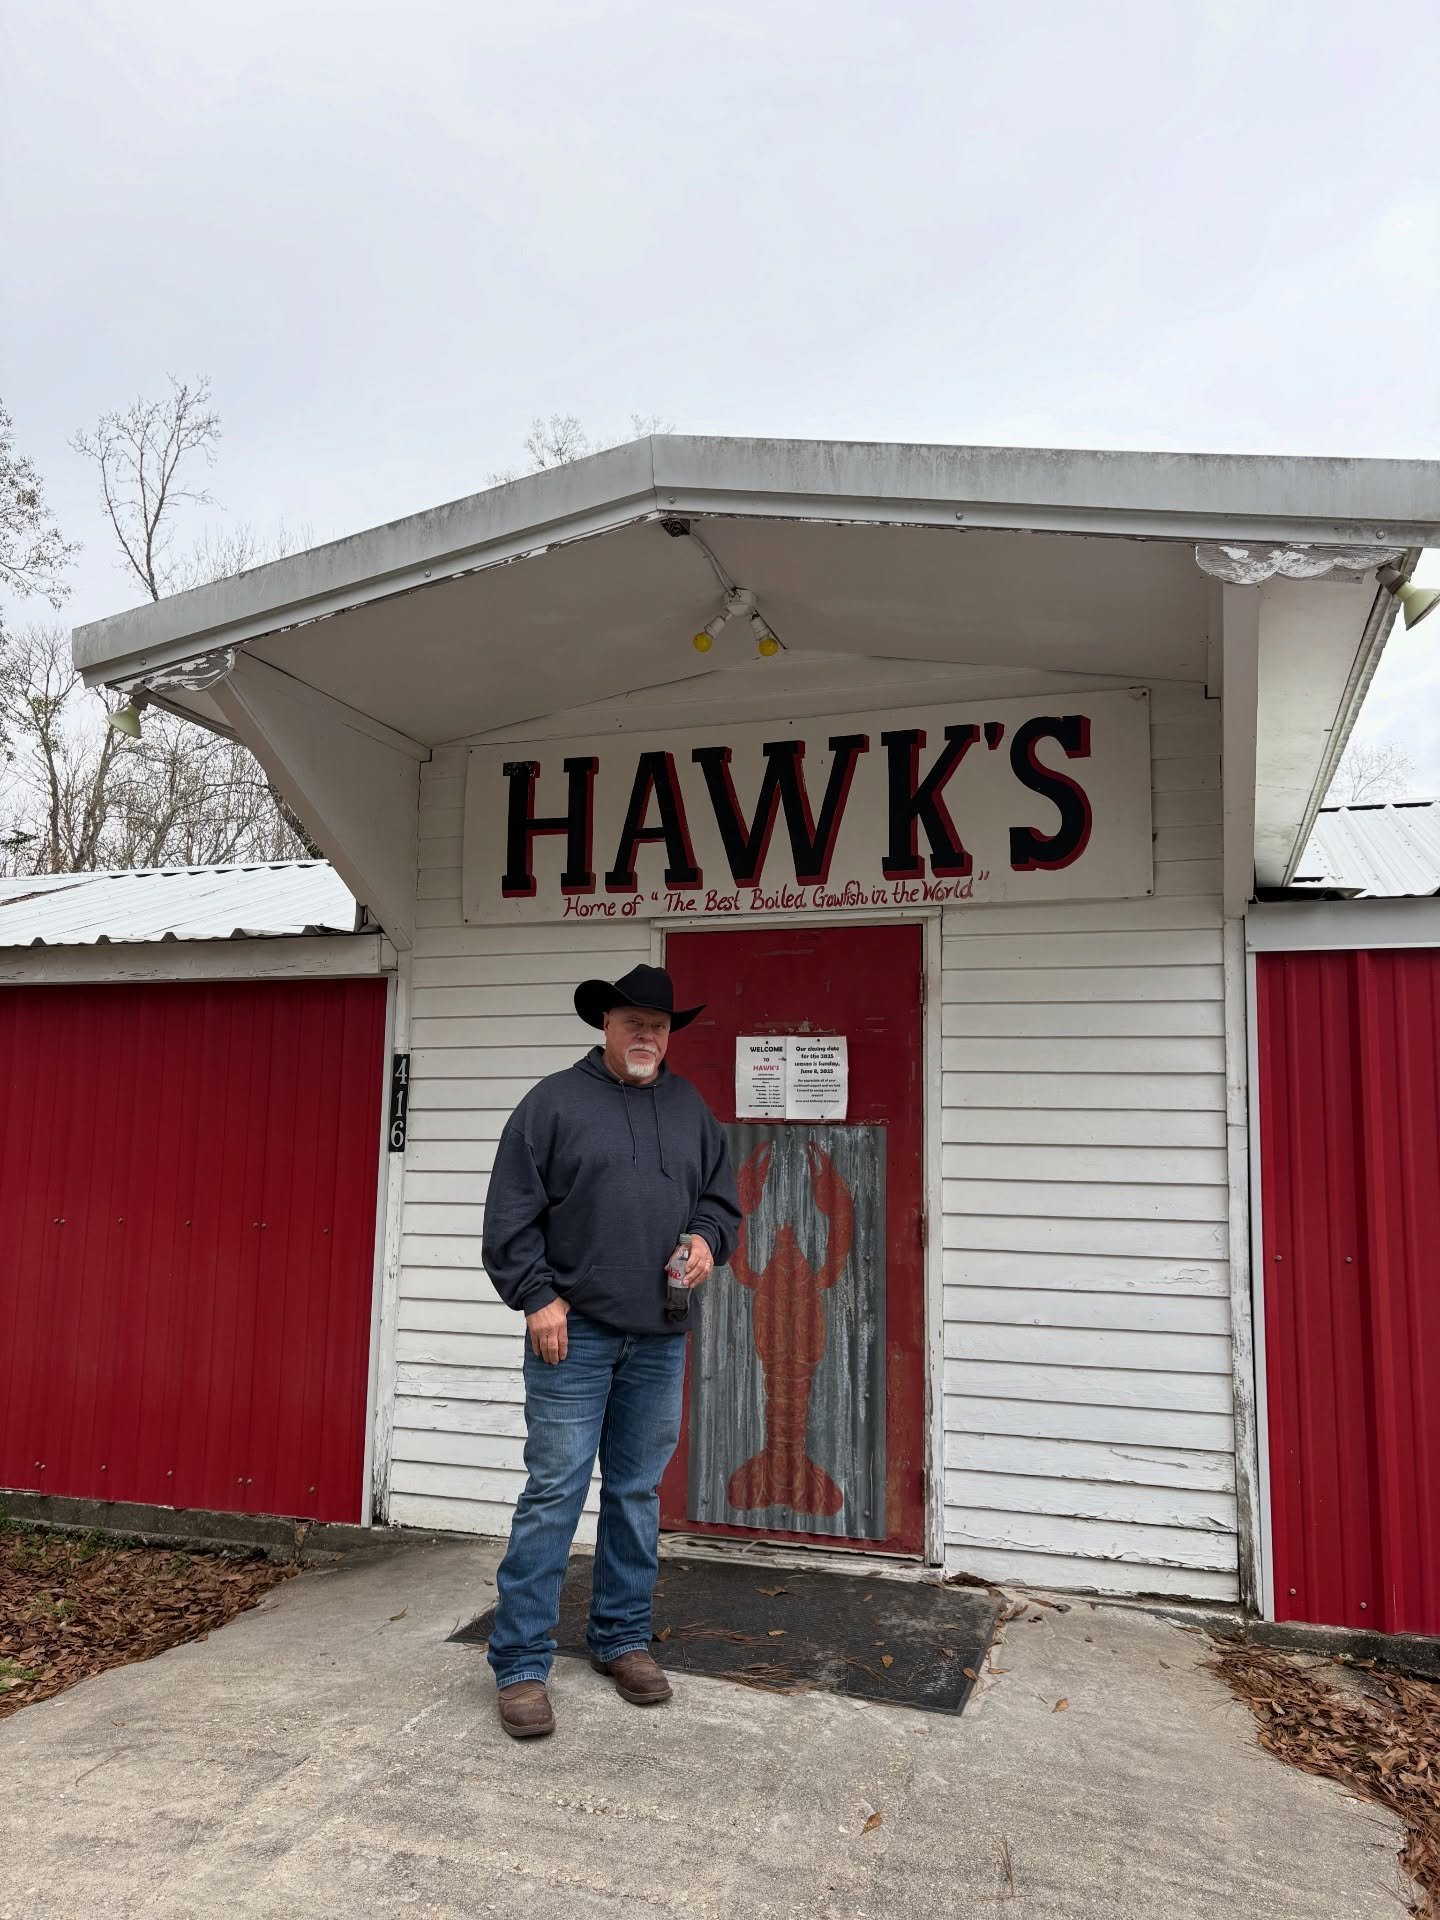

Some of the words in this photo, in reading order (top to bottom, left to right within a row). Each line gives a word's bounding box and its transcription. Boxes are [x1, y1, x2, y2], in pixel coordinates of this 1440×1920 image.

[501, 714, 1093, 898] HAWK'S
[562, 895, 616, 918] Home
[621, 894, 645, 917] of
[704, 888, 741, 912] Best
[749, 883, 807, 911] Boiled
[871, 885, 888, 905] in
[891, 880, 920, 904] the
[390, 1058, 408, 1148] 416
